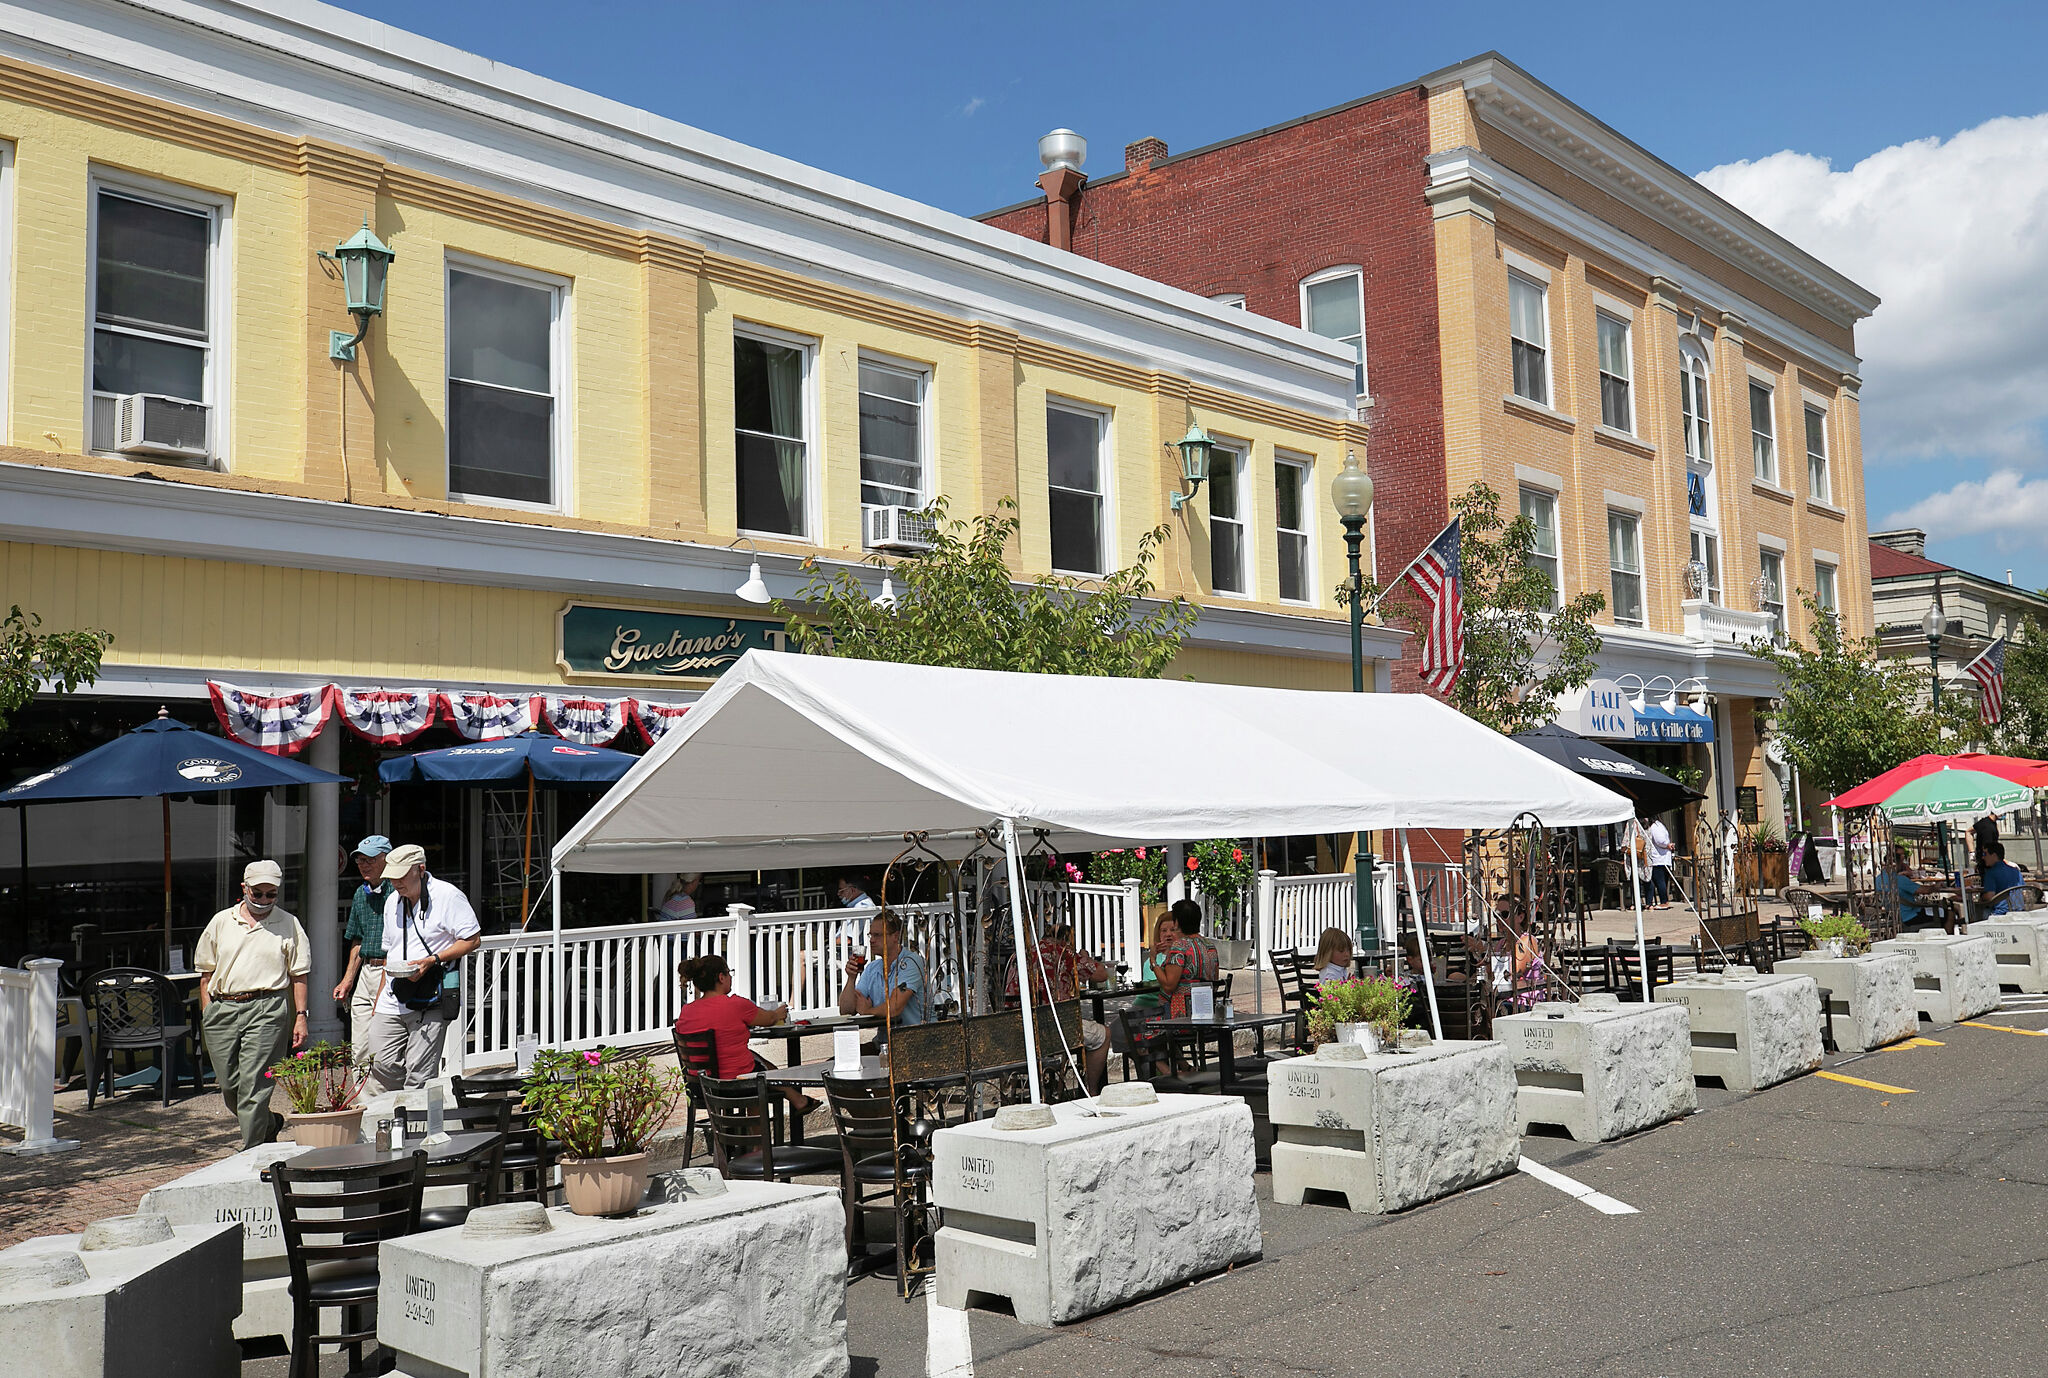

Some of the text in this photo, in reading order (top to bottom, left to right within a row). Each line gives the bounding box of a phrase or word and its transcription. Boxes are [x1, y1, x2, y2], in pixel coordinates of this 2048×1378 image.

[603, 620, 746, 670] Gaetano's
[1591, 690, 1622, 709] HALF
[1591, 714, 1625, 732] MOON
[1651, 721, 1659, 737] &
[1660, 721, 1684, 738] Grille
[1684, 722, 1704, 739] Cafe
[184, 759, 222, 767] GOOSE
[201, 773, 238, 783] ISLAND
[1523, 1027, 1554, 1039] UNITED
[1525, 1040, 1553, 1050] 2-27-20
[1287, 1071, 1319, 1085] UNITED
[1288, 1085, 1321, 1099] 2-26-20
[961, 1156, 994, 1175] UNITED
[215, 1206, 273, 1223] UNITED
[243, 1223, 278, 1241] 8-20
[405, 1273, 436, 1302] UNITED
[405, 1300, 435, 1327] 2-24-20
